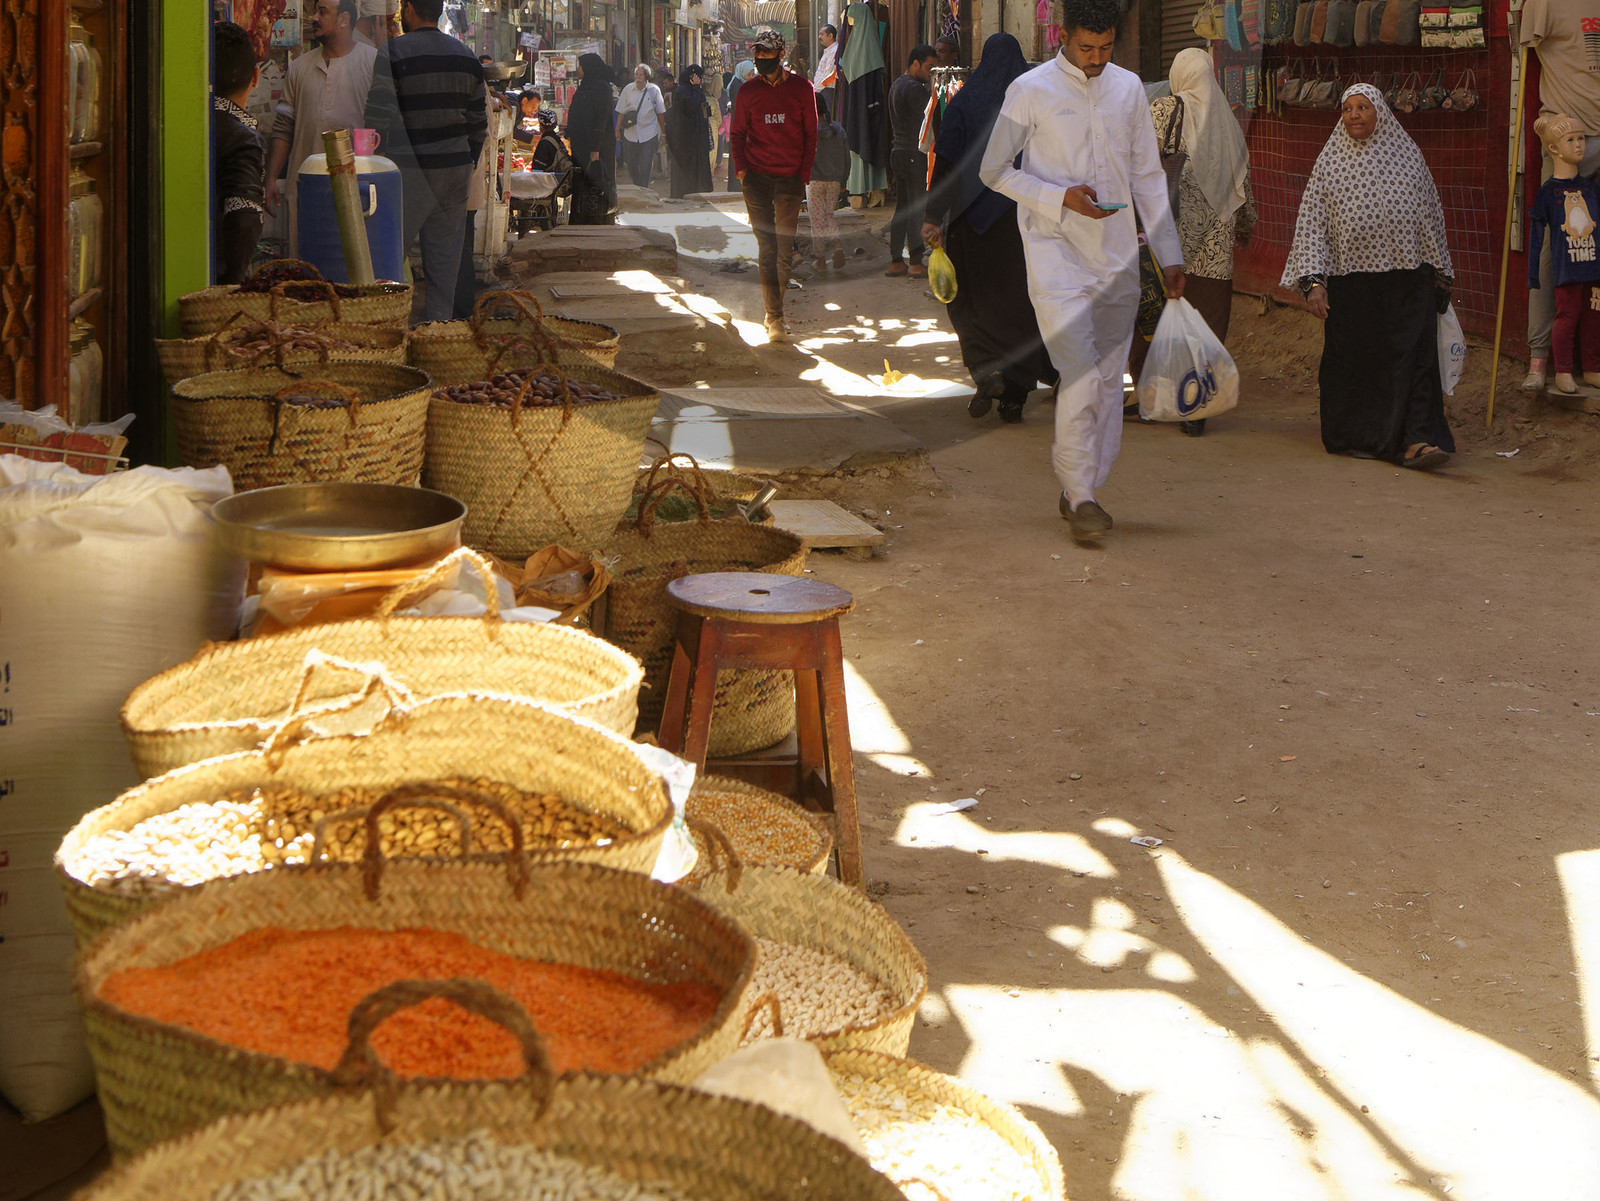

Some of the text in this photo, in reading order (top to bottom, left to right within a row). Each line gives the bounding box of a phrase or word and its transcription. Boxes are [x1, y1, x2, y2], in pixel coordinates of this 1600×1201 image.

[764, 113, 786, 125] RAW
[1566, 235, 1596, 249] YOGA
[1568, 248, 1597, 263] TIME
